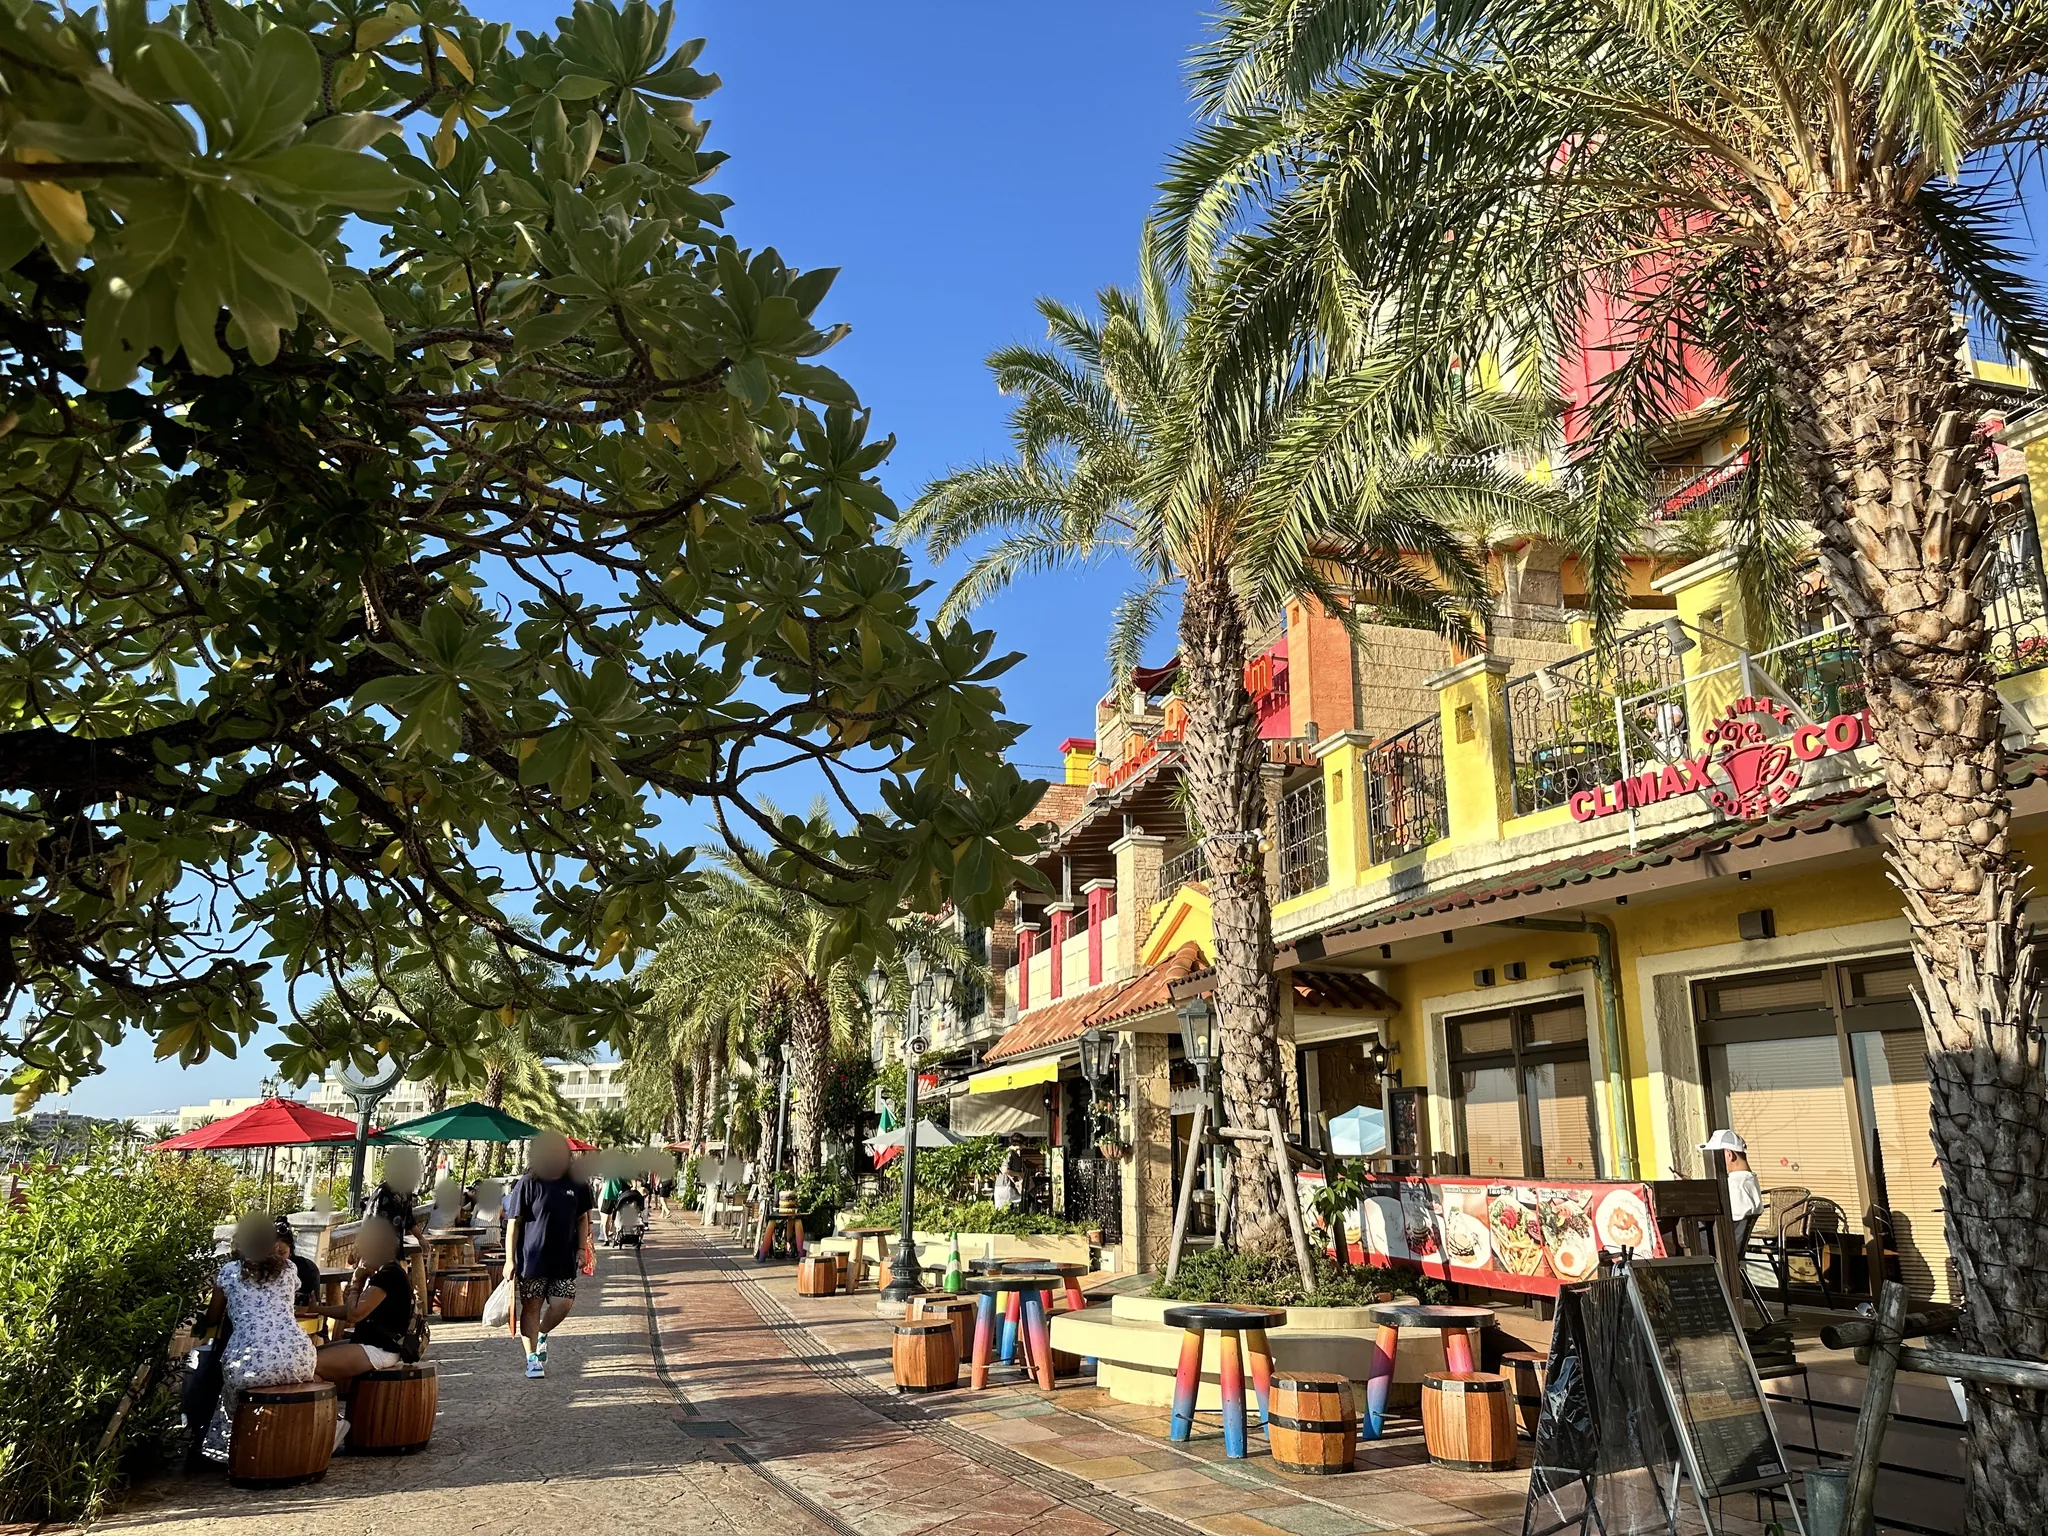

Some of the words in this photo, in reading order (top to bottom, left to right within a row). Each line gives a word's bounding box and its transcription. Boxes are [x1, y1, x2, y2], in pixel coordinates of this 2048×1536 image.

[1702, 696, 1794, 744] CLIMAX
[1269, 740, 1323, 767] BLU
[1569, 754, 1716, 823] CLIMAX
[1710, 769, 1802, 819] COFFEE
